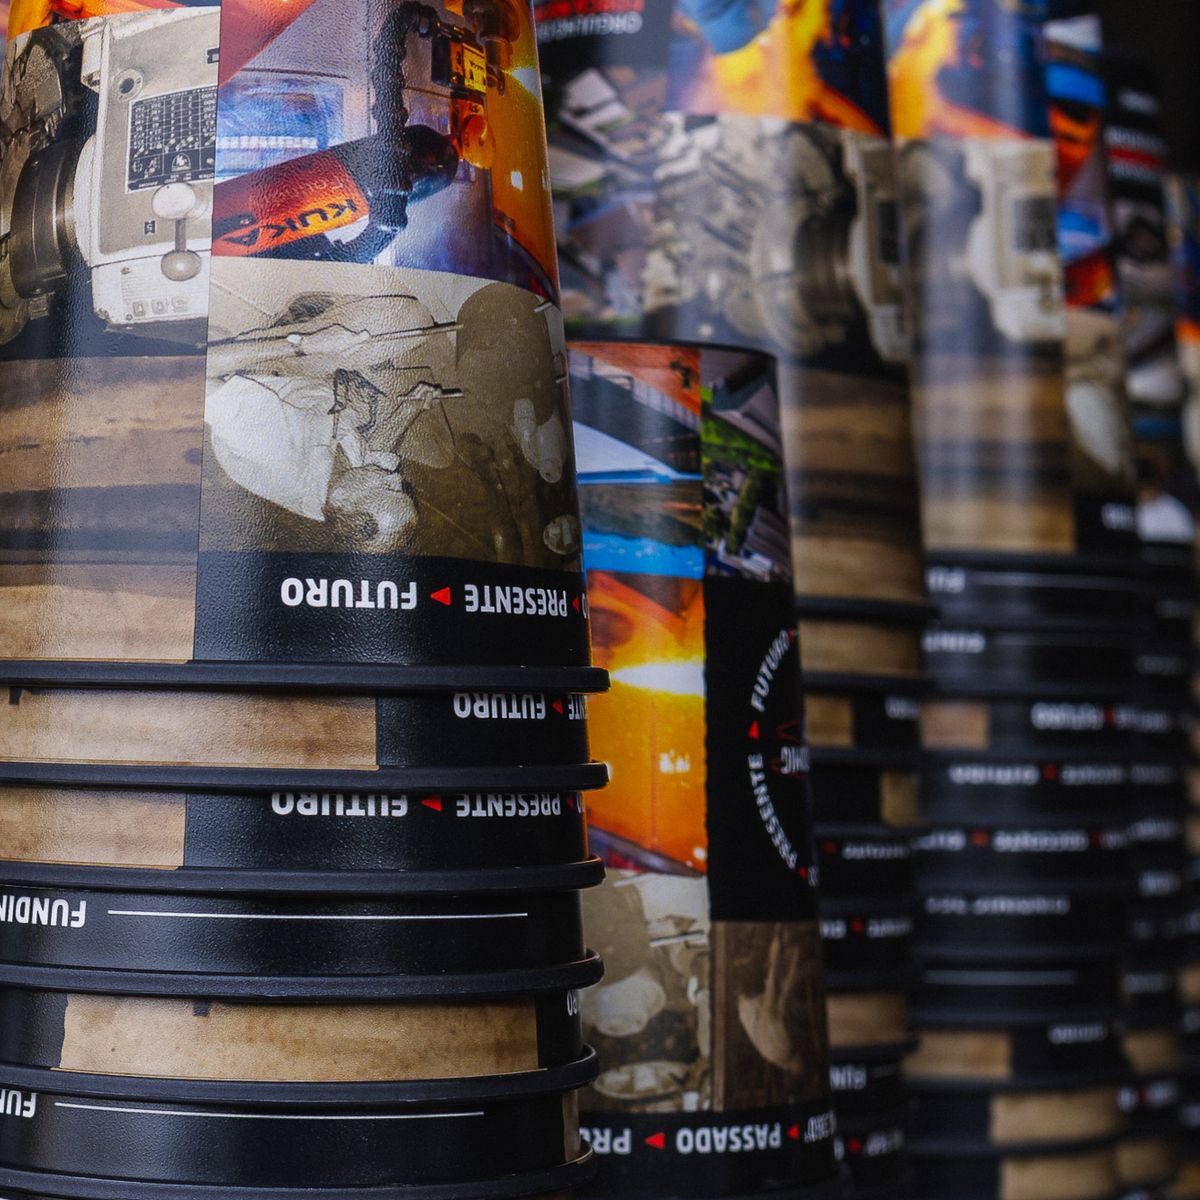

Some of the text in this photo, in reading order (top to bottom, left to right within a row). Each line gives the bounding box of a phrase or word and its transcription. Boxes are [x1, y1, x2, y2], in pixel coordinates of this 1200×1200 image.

[223, 199, 358, 247] KUKA
[281, 578, 417, 609] FUTURO
[465, 584, 567, 616] PRESENTE
[454, 696, 545, 719] FUTURO
[272, 795, 407, 817] FUTURO
[457, 796, 560, 817] PRESENTE
[676, 1124, 781, 1156] PASSADO
